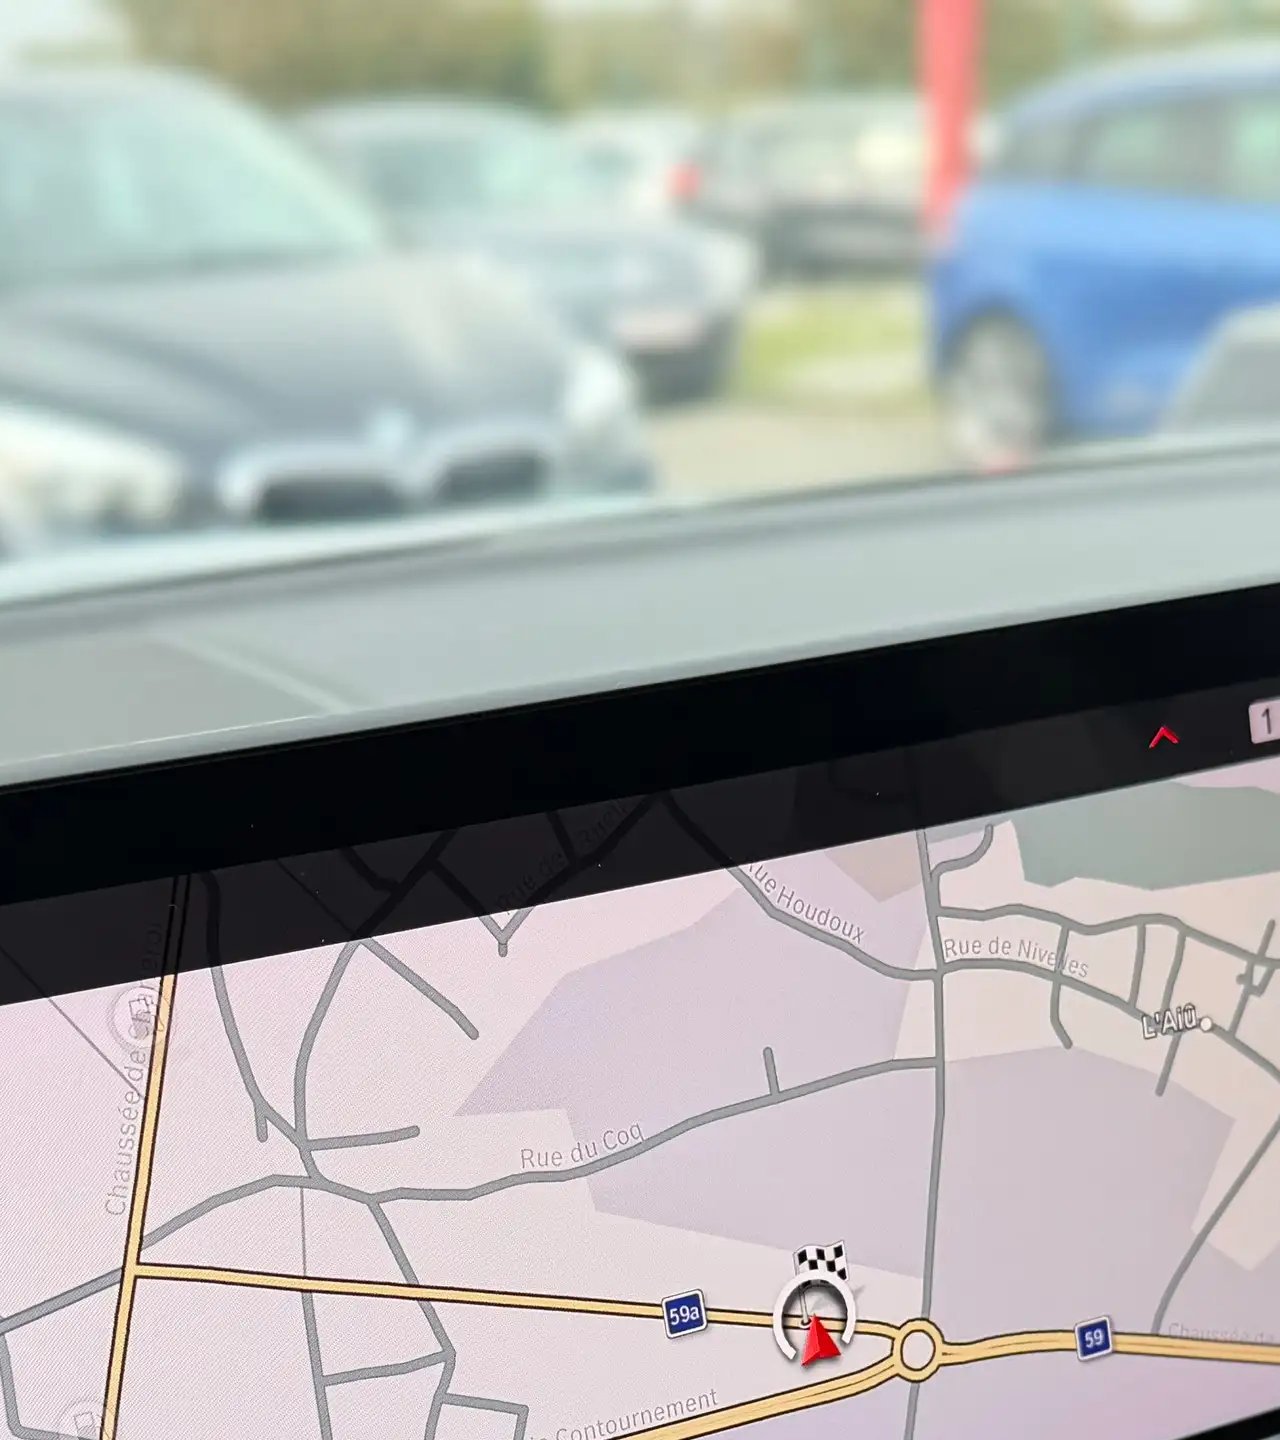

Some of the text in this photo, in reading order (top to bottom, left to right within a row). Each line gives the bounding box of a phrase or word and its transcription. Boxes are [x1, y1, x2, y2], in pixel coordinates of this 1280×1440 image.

[1260, 708, 1275, 736] 1
[749, 863, 865, 944] ue Houdoux
[944, 936, 1089, 978] Rue de Nivelles
[105, 1091, 141, 1215] Chaussée
[126, 1051, 147, 1082] de
[520, 1122, 645, 1170] Rue du Coq
[669, 1303, 701, 1327] 59a
[1084, 1327, 1104, 1350] 59
